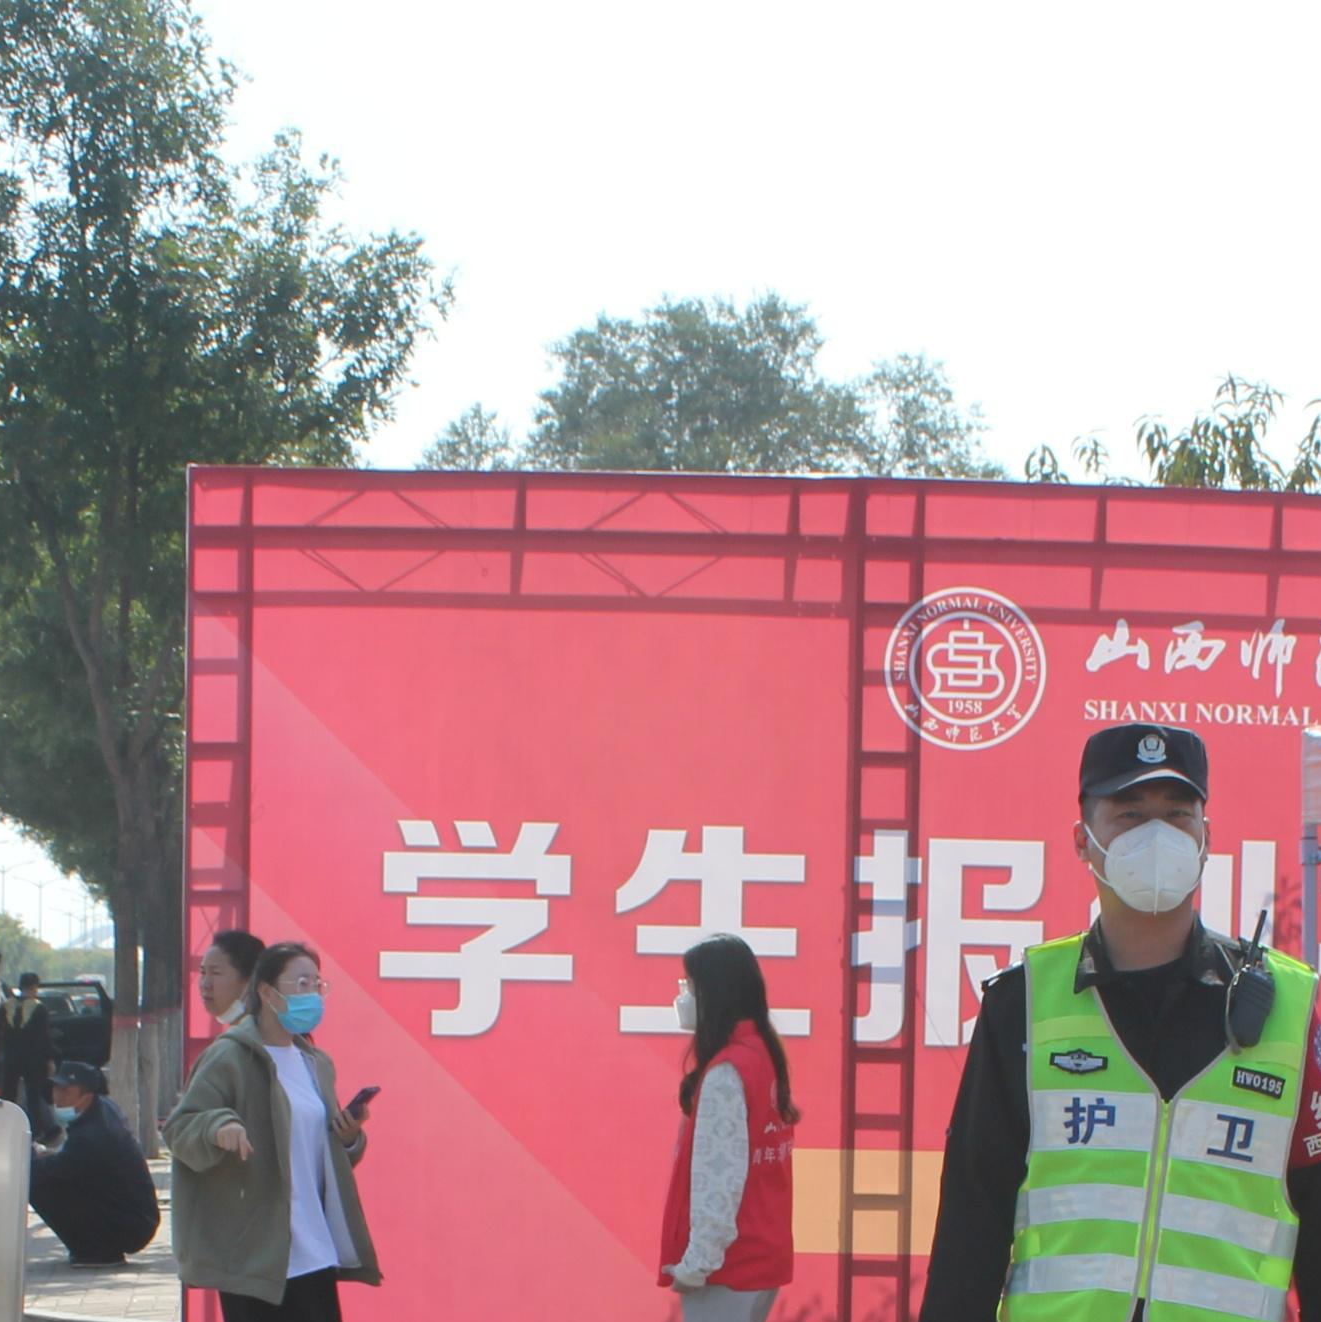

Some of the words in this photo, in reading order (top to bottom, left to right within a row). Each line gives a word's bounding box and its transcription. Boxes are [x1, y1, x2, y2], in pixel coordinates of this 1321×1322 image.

[893, 621, 920, 681] SHANXI
[917, 596, 984, 623] NORMAL
[986, 601, 1038, 685] UNIVERSITY
[947, 699, 983, 715] 1958
[1083, 699, 1188, 724] SHANXI
[1195, 702, 1318, 727] NORMAL
[1063, 1097, 1116, 1145] 护
[1206, 1113, 1255, 1163] 卫
